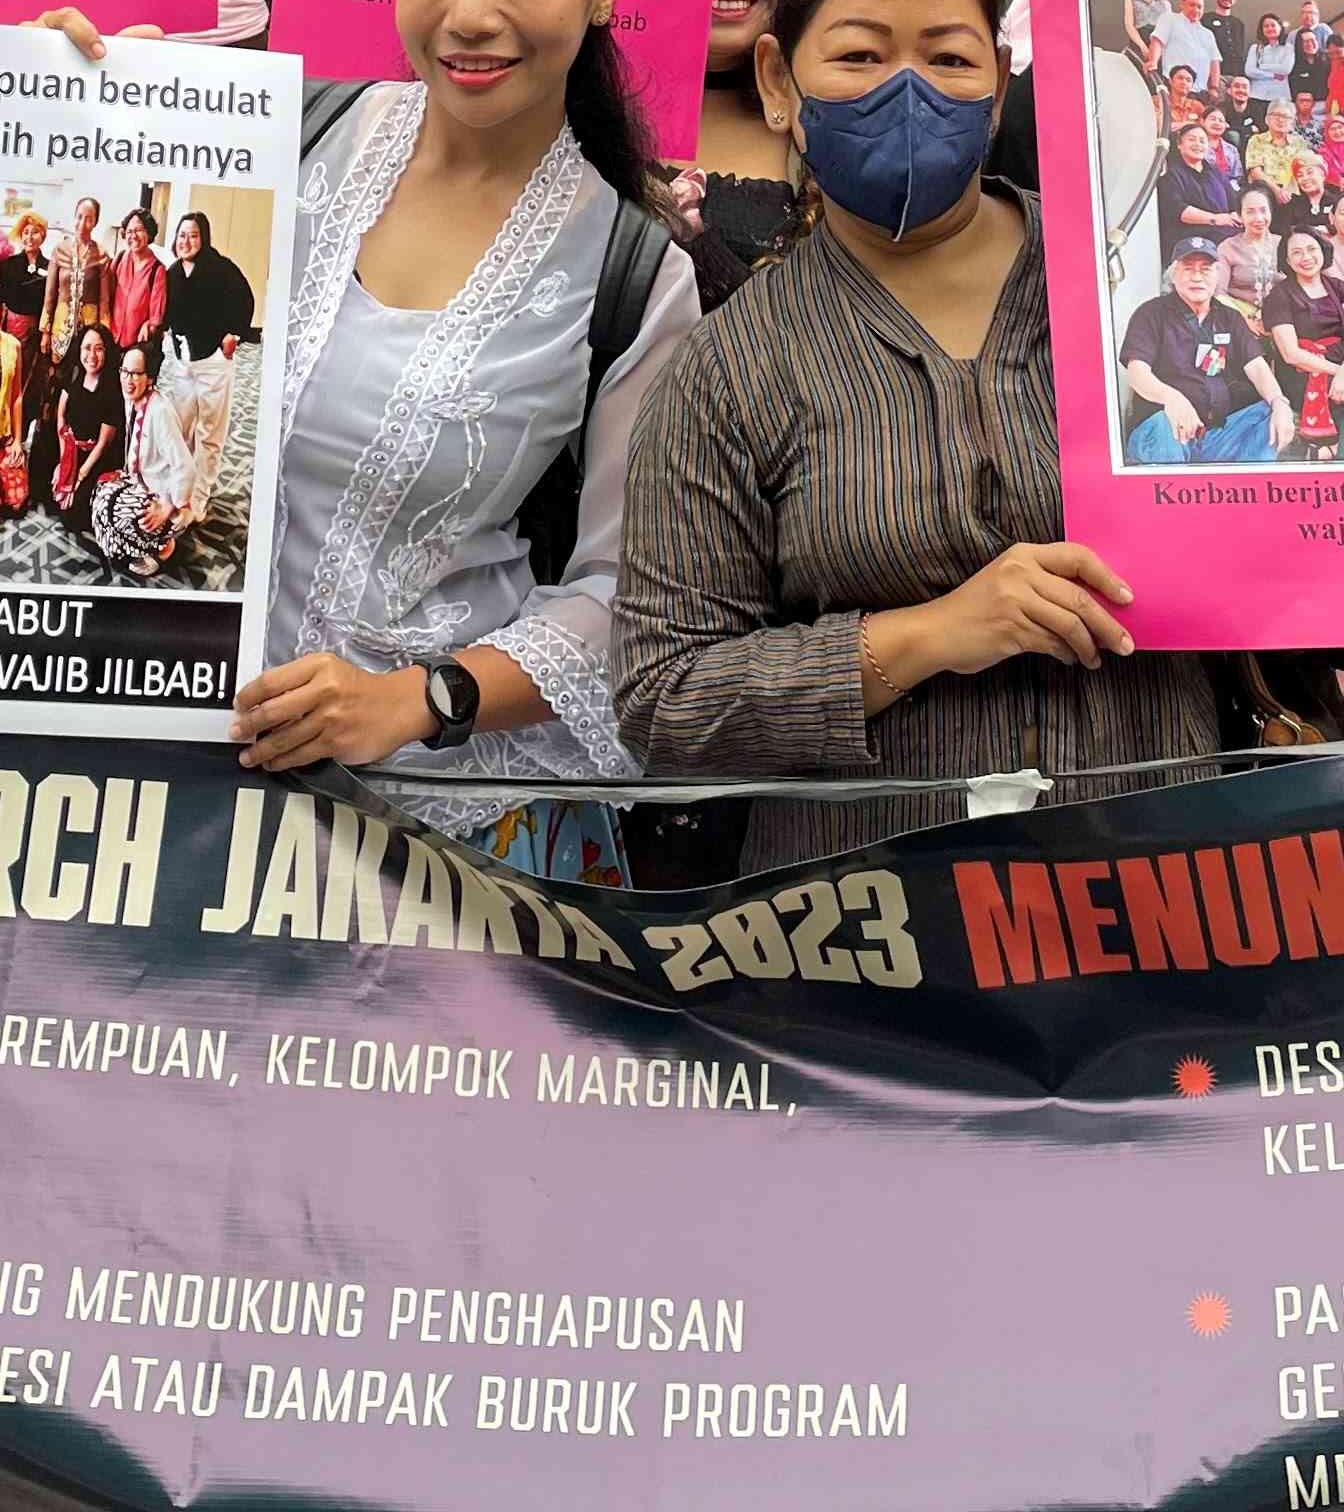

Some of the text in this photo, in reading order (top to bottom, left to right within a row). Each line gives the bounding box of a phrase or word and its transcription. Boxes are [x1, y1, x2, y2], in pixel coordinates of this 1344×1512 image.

[97, 69, 274, 118] berdaulat
[45, 128, 255, 177] pakaiannya
[1153, 479, 1257, 507] Korban
[95, 657, 229, 700] JILBAB!
[200, 786, 636, 972] JAKARTA
[641, 868, 924, 992] 2023
[264, 1034, 513, 1100] KELOMPOK
[536, 1052, 798, 1118] MARGINAL,
[64, 1265, 367, 1339] MENDUKUNG
[386, 1286, 746, 1353] PENGHAPUSAN
[90, 1353, 222, 1418] ATAU
[243, 1363, 455, 1428] DAMPAK
[474, 1374, 639, 1437] BURUK
[661, 1382, 909, 1439] PROGRAM
